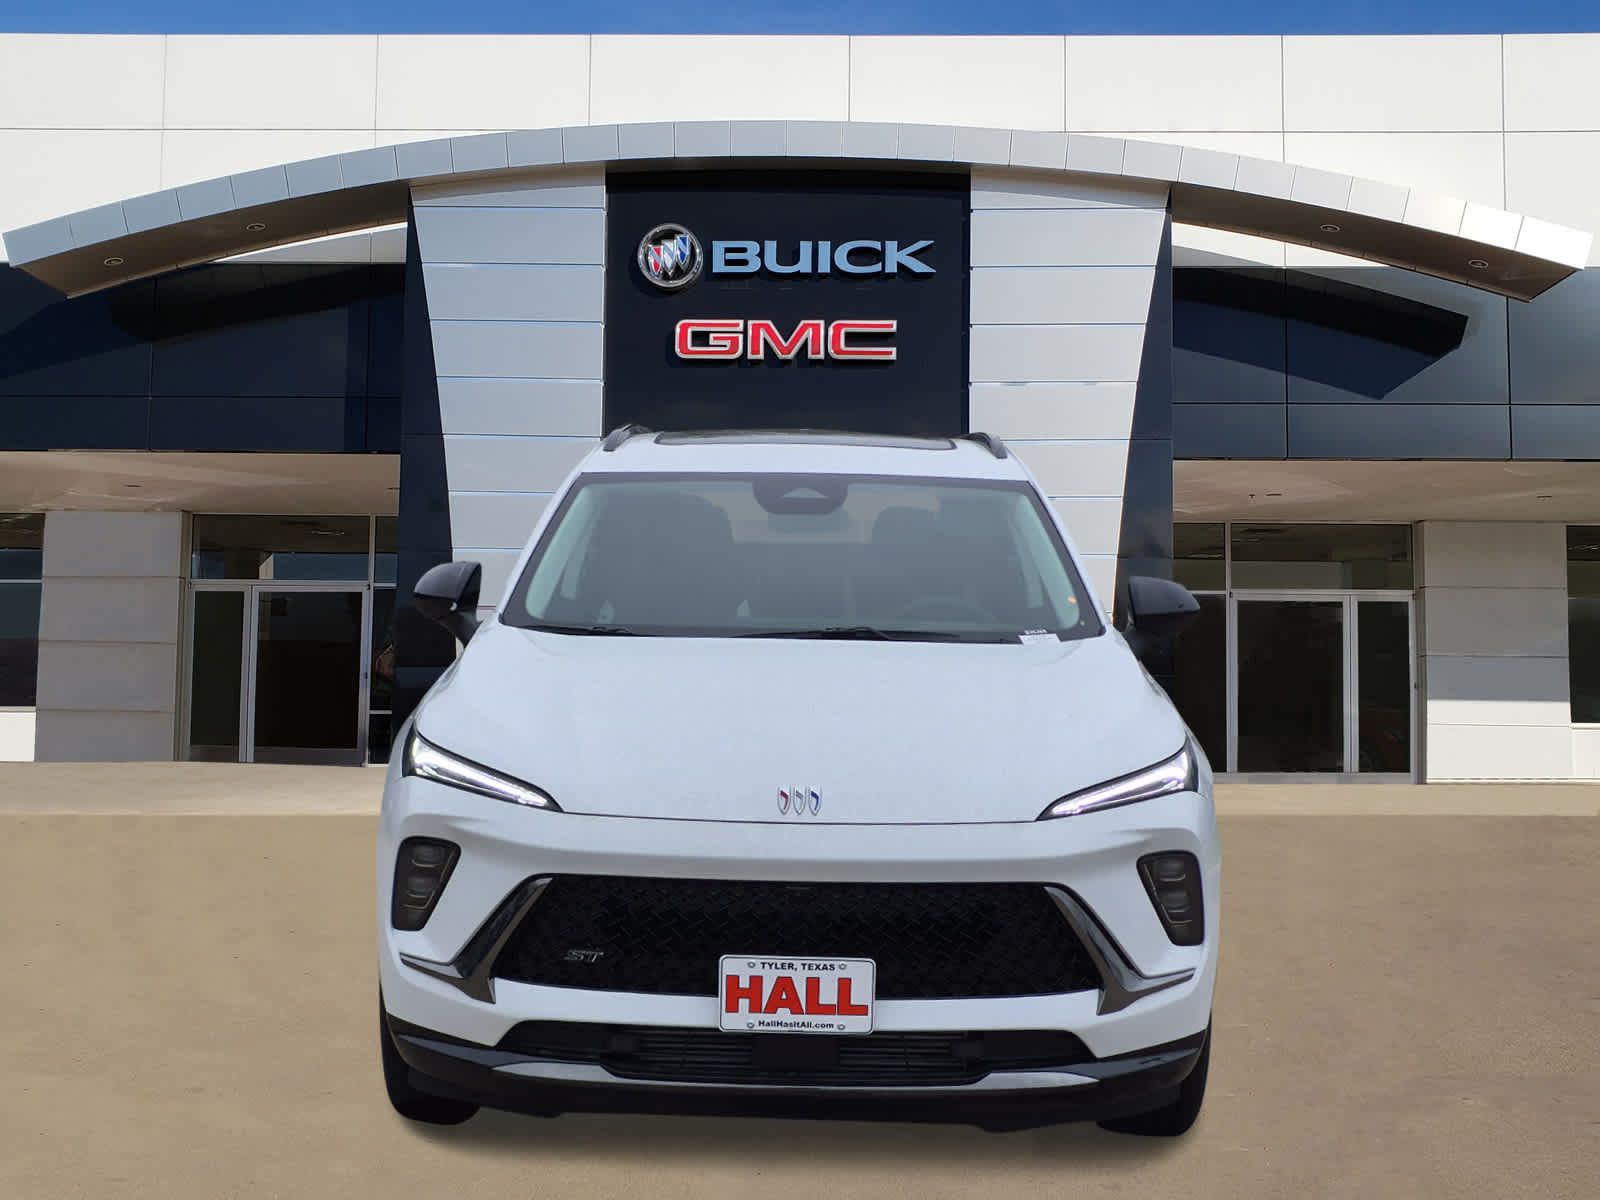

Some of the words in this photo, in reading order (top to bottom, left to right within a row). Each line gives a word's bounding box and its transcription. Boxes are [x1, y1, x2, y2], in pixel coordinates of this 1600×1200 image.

[712, 240, 937, 273] BUICK
[675, 319, 897, 360] GMC
[563, 950, 604, 963] ST
[760, 962, 798, 971] TYLER,
[801, 963, 836, 971] TEXAS
[725, 975, 869, 1016] HALL
[758, 1020, 834, 1030] HallHasItAll.com
